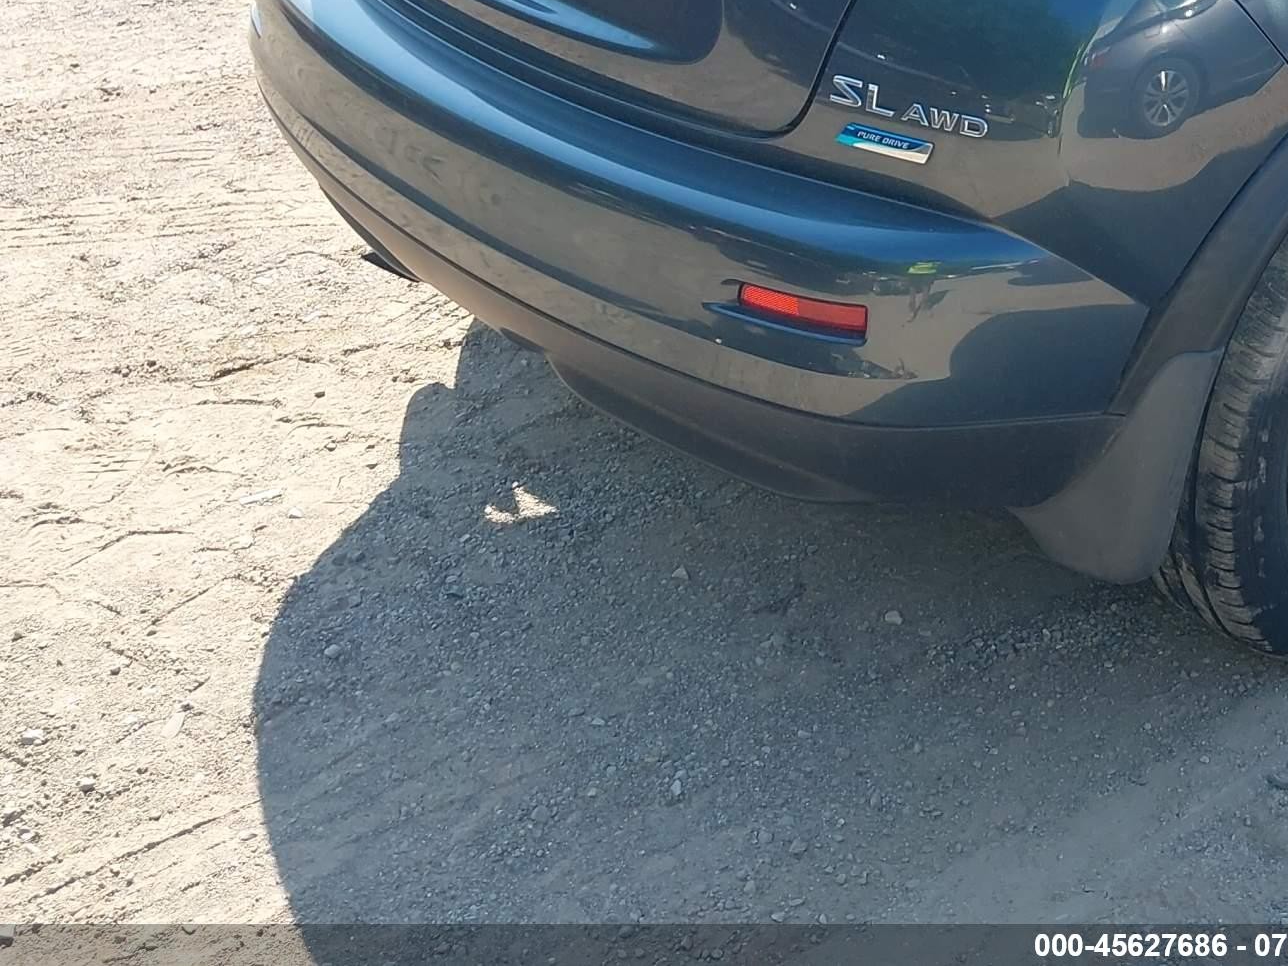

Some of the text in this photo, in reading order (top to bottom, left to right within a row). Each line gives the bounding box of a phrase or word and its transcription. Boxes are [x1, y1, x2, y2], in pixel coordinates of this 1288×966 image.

[829, 74, 989, 138] SL AWD
[857, 130, 910, 150] PURE DRIVE
